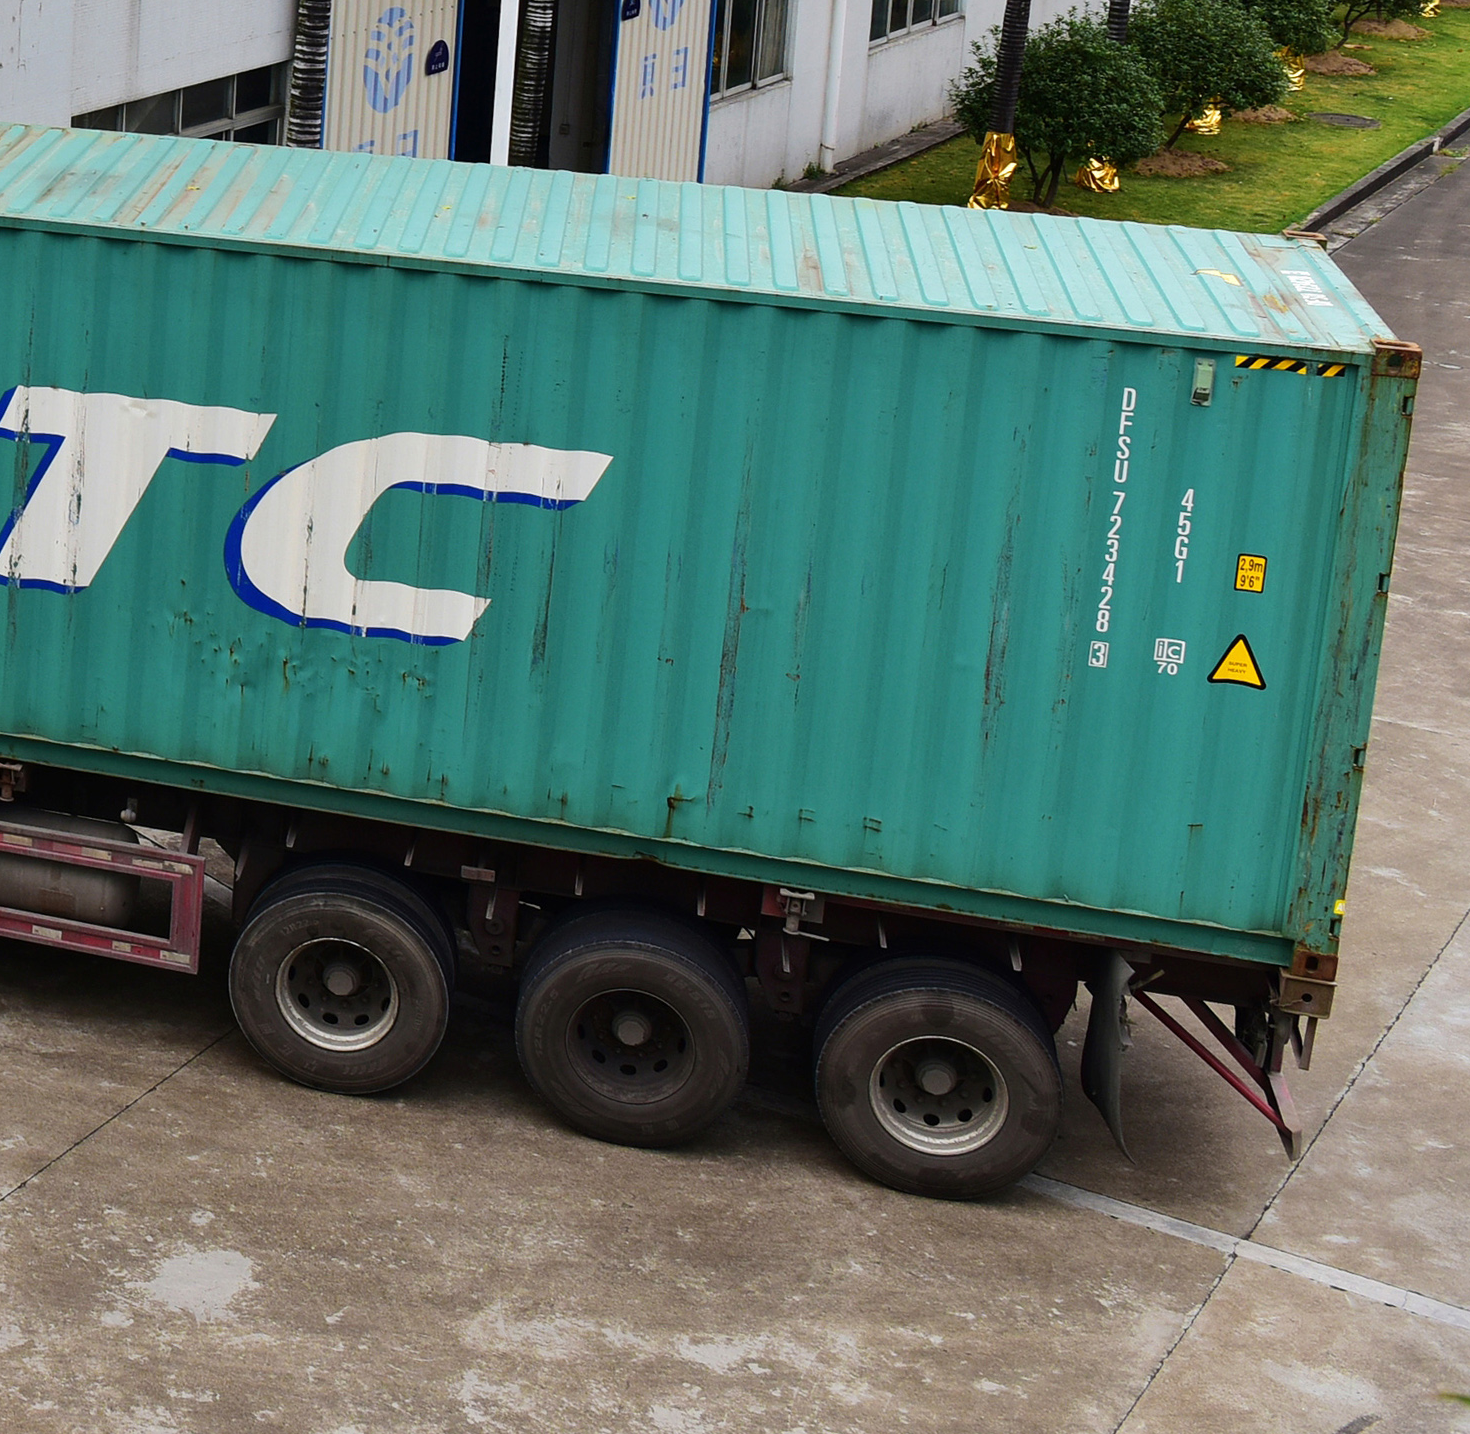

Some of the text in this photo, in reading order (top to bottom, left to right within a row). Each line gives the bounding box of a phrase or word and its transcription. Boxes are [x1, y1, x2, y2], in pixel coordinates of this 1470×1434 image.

[1113, 387, 1137, 484] DFSU
[1095, 491, 1126, 633] 723428
[1174, 488, 1194, 583] 45G1
[1240, 558, 1263, 574] 2,9m
[1156, 661, 1178, 675] 70
